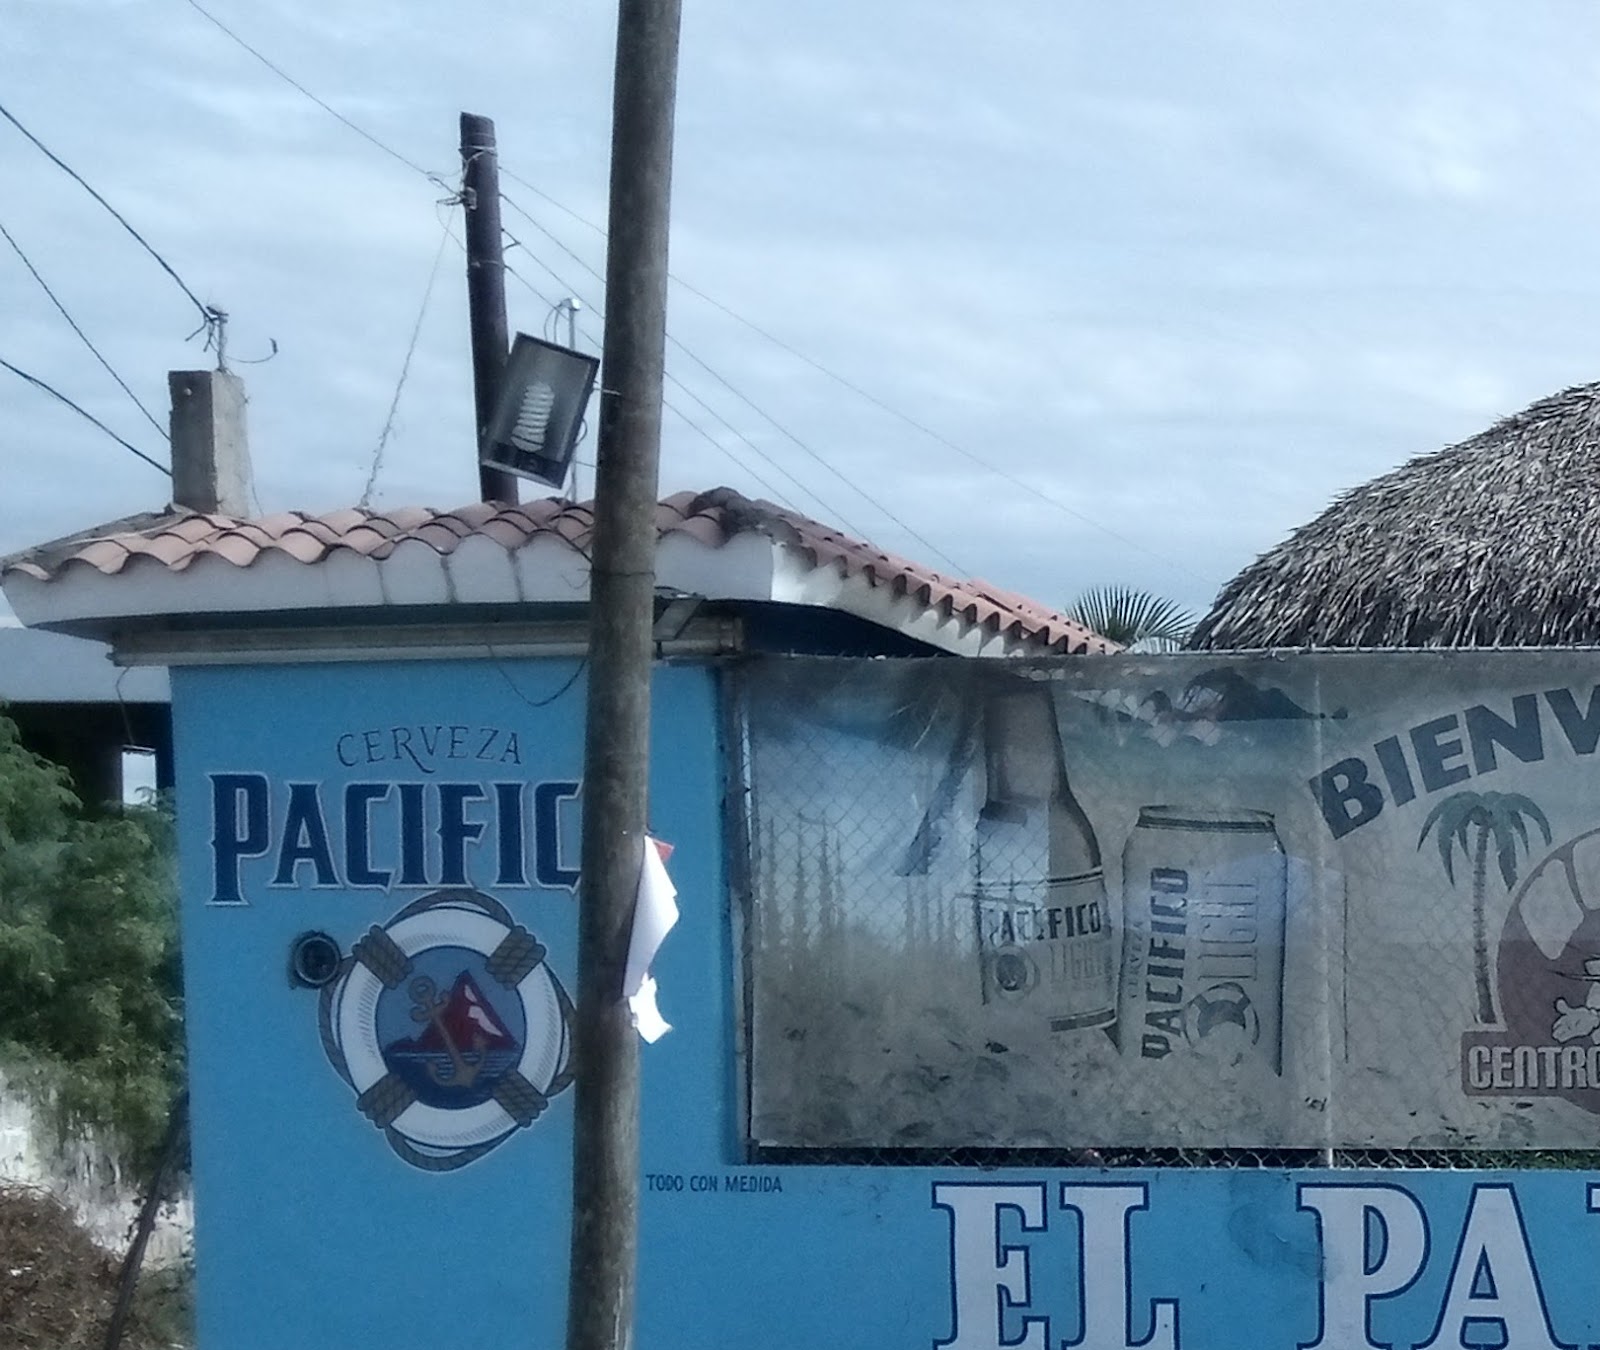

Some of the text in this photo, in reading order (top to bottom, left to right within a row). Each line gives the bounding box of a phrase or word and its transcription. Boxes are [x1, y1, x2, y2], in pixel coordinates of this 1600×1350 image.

[336, 726, 522, 774] CERVEZA
[206, 772, 584, 906] PACIFIC
[1141, 867, 1188, 1058] PACIFICO
[645, 1174, 783, 1193] TODO CON MEDIDA
